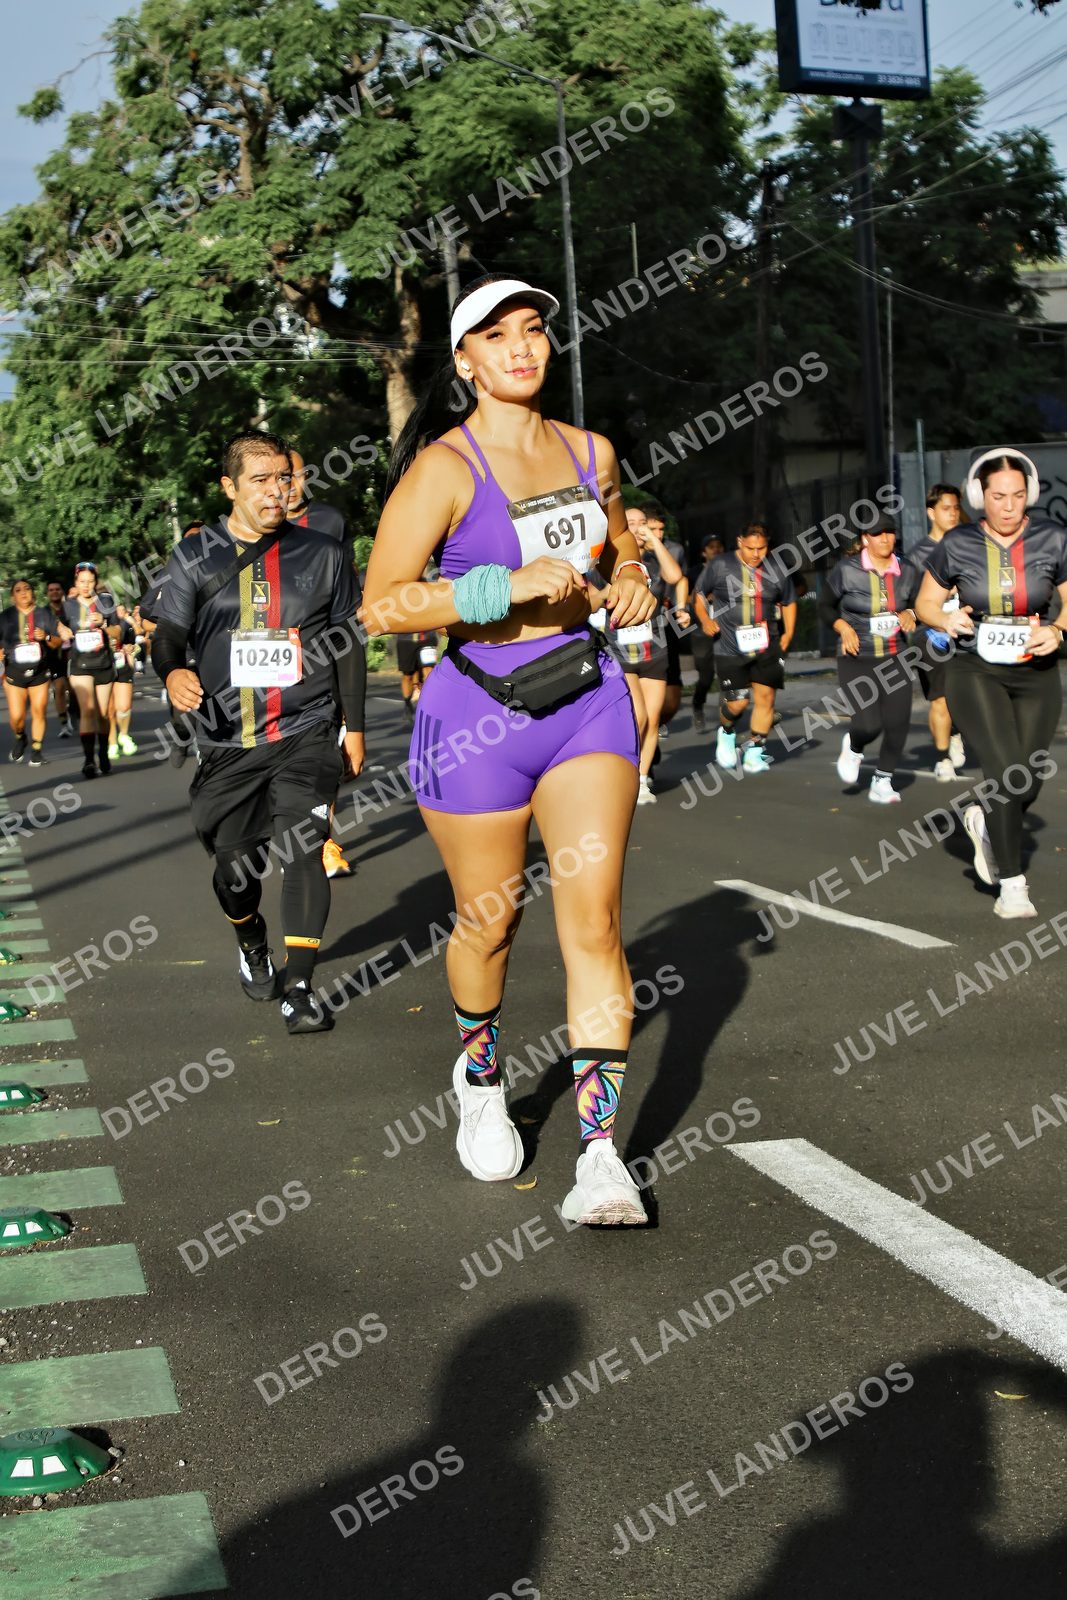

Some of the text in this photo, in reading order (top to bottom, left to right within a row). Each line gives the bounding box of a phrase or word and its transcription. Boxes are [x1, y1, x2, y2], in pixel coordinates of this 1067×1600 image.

[544, 513, 586, 549] 697
[987, 631, 1026, 647] 9245
[235, 648, 293, 667] 10249
